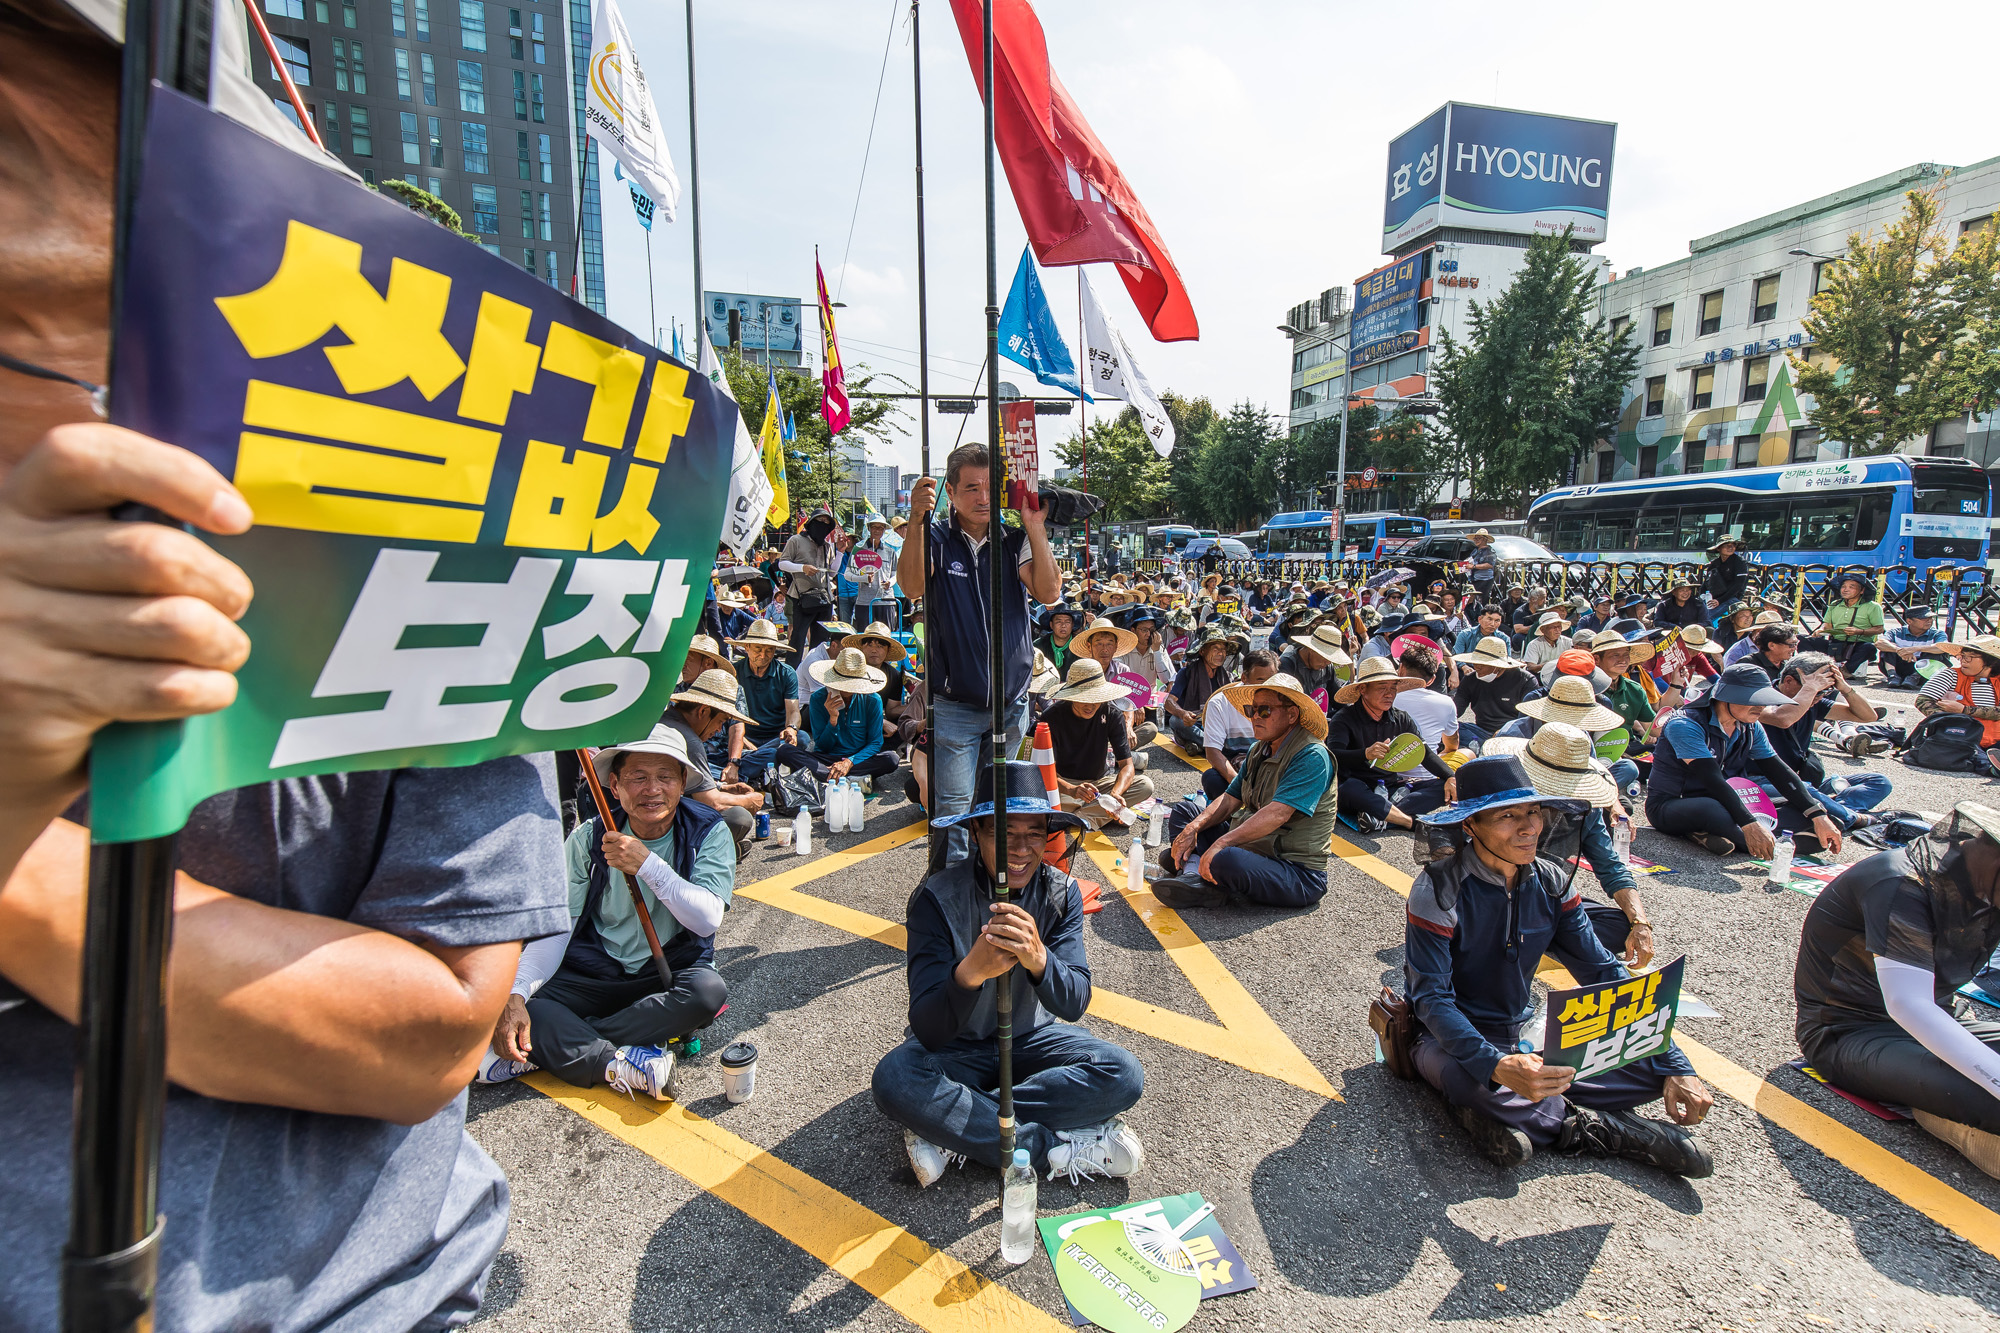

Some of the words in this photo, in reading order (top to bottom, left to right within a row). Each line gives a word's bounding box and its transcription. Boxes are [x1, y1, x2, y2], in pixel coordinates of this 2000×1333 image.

[1391, 144, 1439, 202] 효성
[1455, 142, 1602, 188] HYOSUNG
[1397, 228, 1411, 240] Always
[1535, 219, 1558, 231] Always
[1559, 222, 1567, 232] by
[1583, 224, 1596, 234] side
[1361, 261, 1414, 299] 특급임대
[1438, 275, 1479, 289] 서울빌딩
[1703, 347, 1733, 365] 서울
[213, 219, 695, 556] 쌀값
[1365, 470, 1375, 480] 50
[1785, 468, 1813, 479] 전기버스
[1816, 467, 1831, 476] 타고
[1816, 477, 1831, 486] 쉬는
[1833, 475, 1857, 485] 서울로
[1962, 501, 1978, 513] 504
[269, 548, 690, 769] 보장
[1557, 970, 1663, 1049] 쌀값
[1574, 1004, 1672, 1082] 보장
[1064, 1243, 1169, 1330] 영암군농민회답게!
